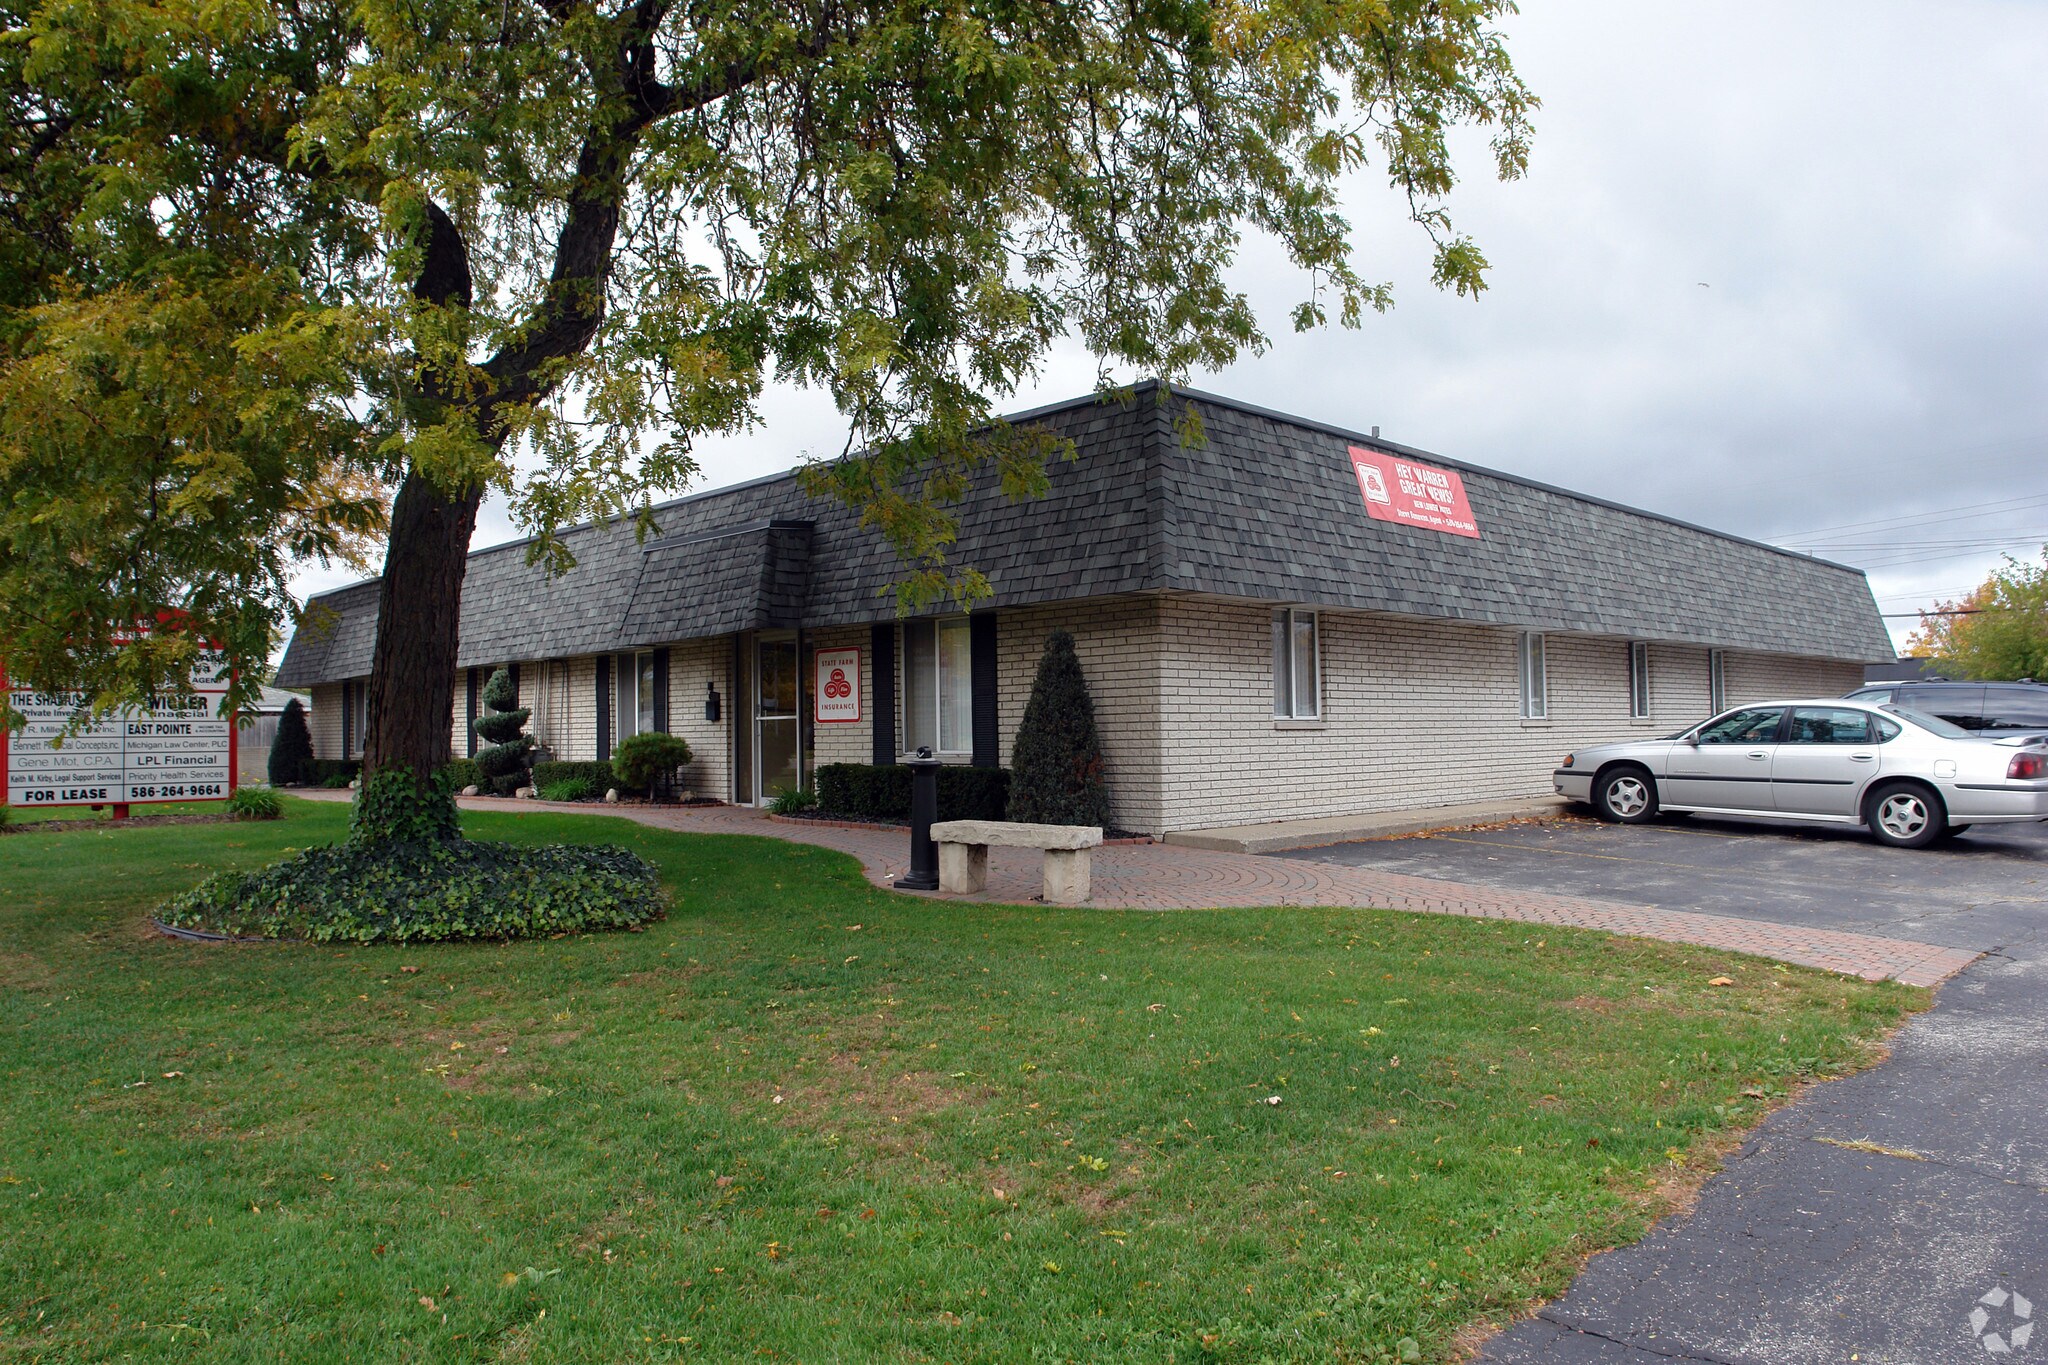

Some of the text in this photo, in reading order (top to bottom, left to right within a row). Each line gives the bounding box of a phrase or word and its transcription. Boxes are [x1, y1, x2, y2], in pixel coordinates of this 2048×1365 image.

[1396, 463, 1449, 488] HEY WARREN
[1400, 480, 1426, 498] GREAT
[11, 693, 33, 706] THE
[21, 708, 51, 717] Private
[41, 725, 62, 733] Mille
[128, 724, 192, 735] EAST POINTE
[13, 741, 41, 750] Bennett
[127, 742, 162, 750] Michigan
[182, 741, 210, 749] Center,
[211, 740, 228, 748] PLC
[18, 757, 49, 767] Gene
[137, 755, 217, 766] LPL Financial
[10, 775, 26, 783] Keith
[37, 774, 54, 784] Kirby,
[54, 774, 71, 783] Legal
[72, 773, 96, 784] Support
[97, 772, 122, 781] Services
[128, 770, 224, 781] Priority Health Services
[25, 789, 108, 802] FOR LEASE
[131, 784, 221, 798] 586-264-9664
